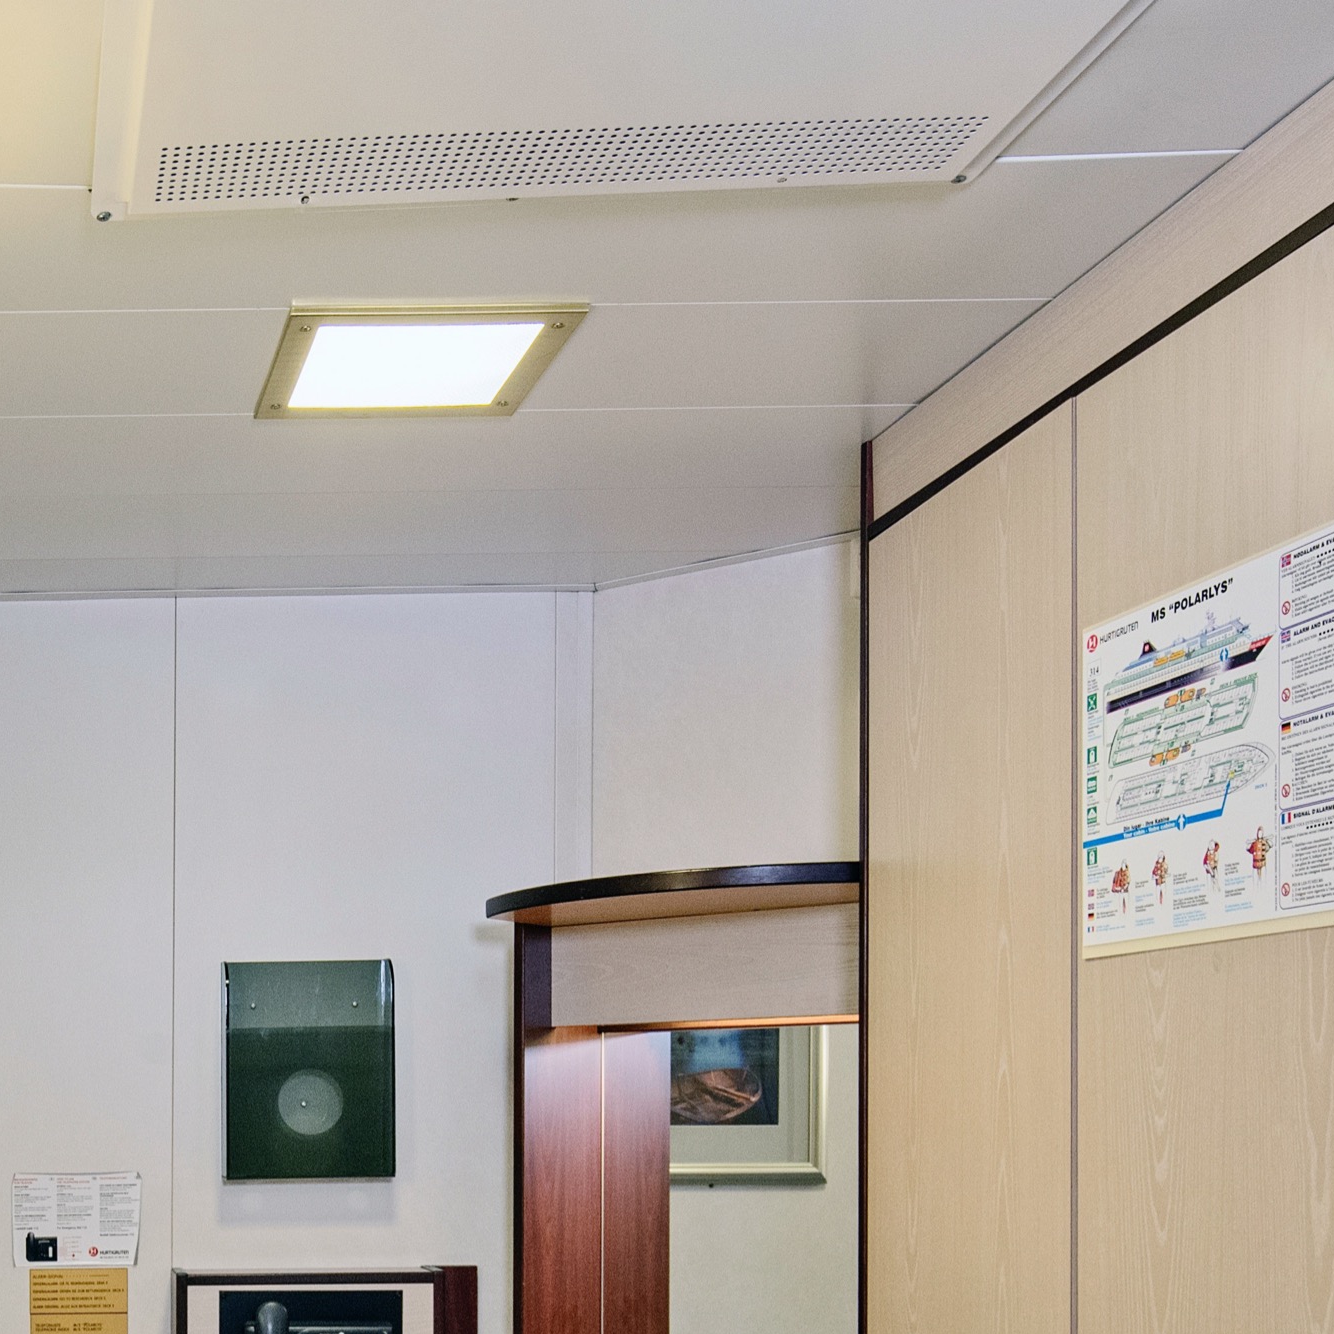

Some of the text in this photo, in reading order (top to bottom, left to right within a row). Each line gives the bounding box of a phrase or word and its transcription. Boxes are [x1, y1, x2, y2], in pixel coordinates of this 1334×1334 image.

[1151, 607, 1166, 623] MS
[1099, 621, 1139, 645] HURTIGRUTEN
[1293, 625, 1310, 637] ALARM
[1310, 621, 1321, 631] AND
[1090, 666, 1100, 677] 314
[1293, 715, 1319, 728] NOTALARM
[1293, 810, 1311, 819] SIGNAL
